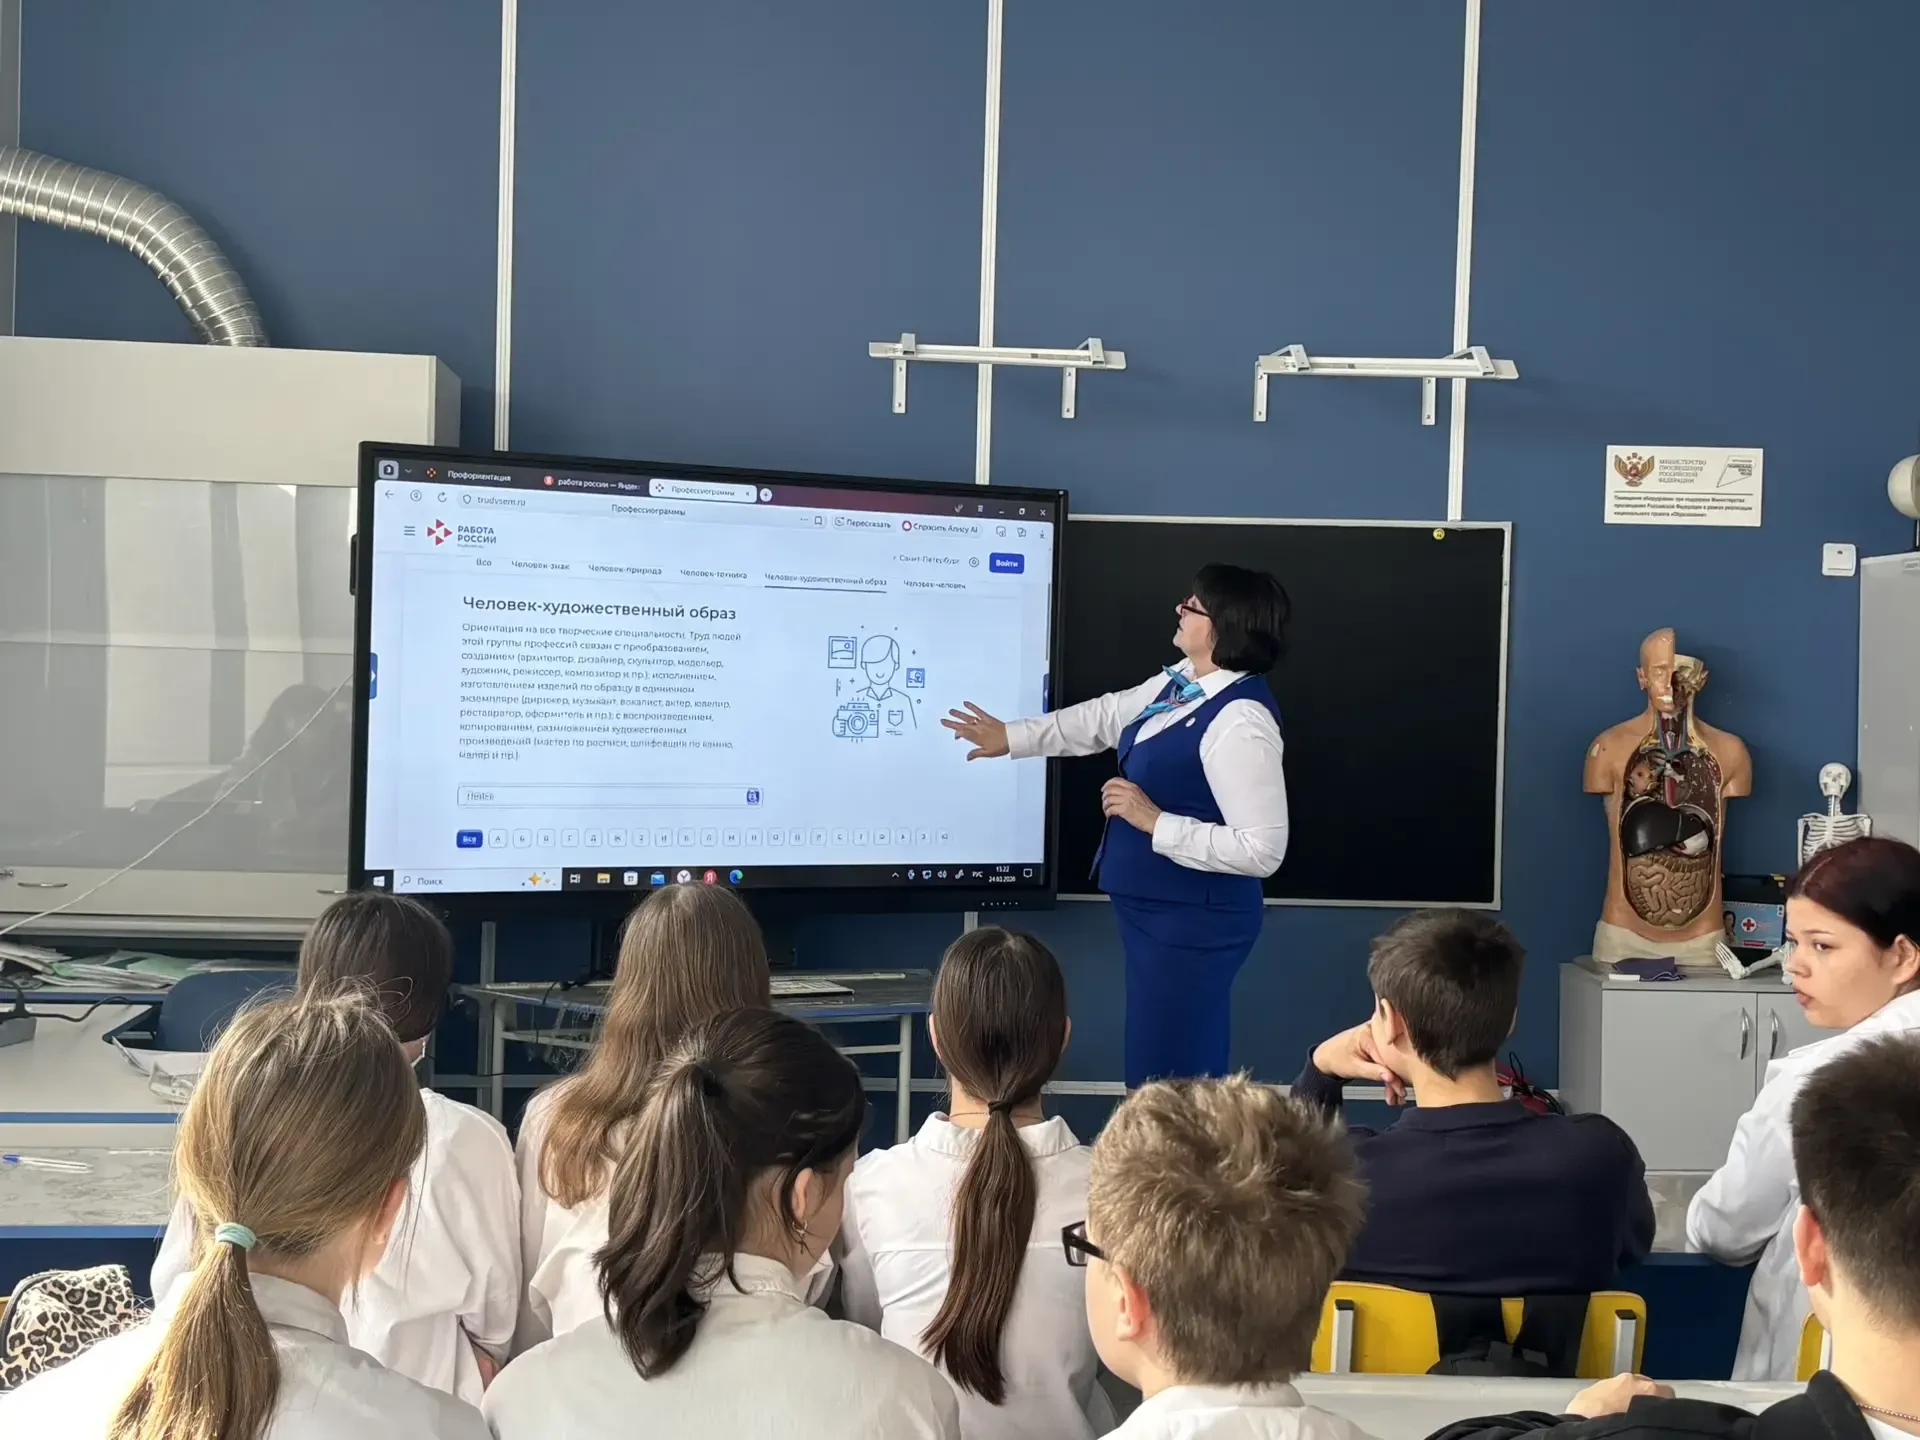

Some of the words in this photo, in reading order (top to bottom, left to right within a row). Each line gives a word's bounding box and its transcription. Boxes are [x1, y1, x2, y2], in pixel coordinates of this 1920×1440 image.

[448, 470, 511, 482] Профориентация
[558, 478, 582, 489] работа
[583, 480, 608, 490] россии
[672, 485, 735, 498] Профессиограммы
[478, 496, 526, 508] trudvsem.ru
[612, 504, 686, 517] Профессиограммы
[846, 518, 892, 529] Пересказать
[913, 522, 946, 532] Спросить
[948, 525, 970, 534] Алису
[458, 525, 494, 536] РАБОТА
[457, 534, 497, 544] РОССИИ
[996, 559, 1018, 568] Войти
[463, 596, 685, 618] Человек-художественный
[689, 606, 736, 621] образ
[462, 623, 524, 633] Ориентация
[690, 631, 710, 641] Труд
[486, 639, 522, 648] группы
[524, 640, 578, 649] профессий
[417, 876, 444, 886] Поиск
